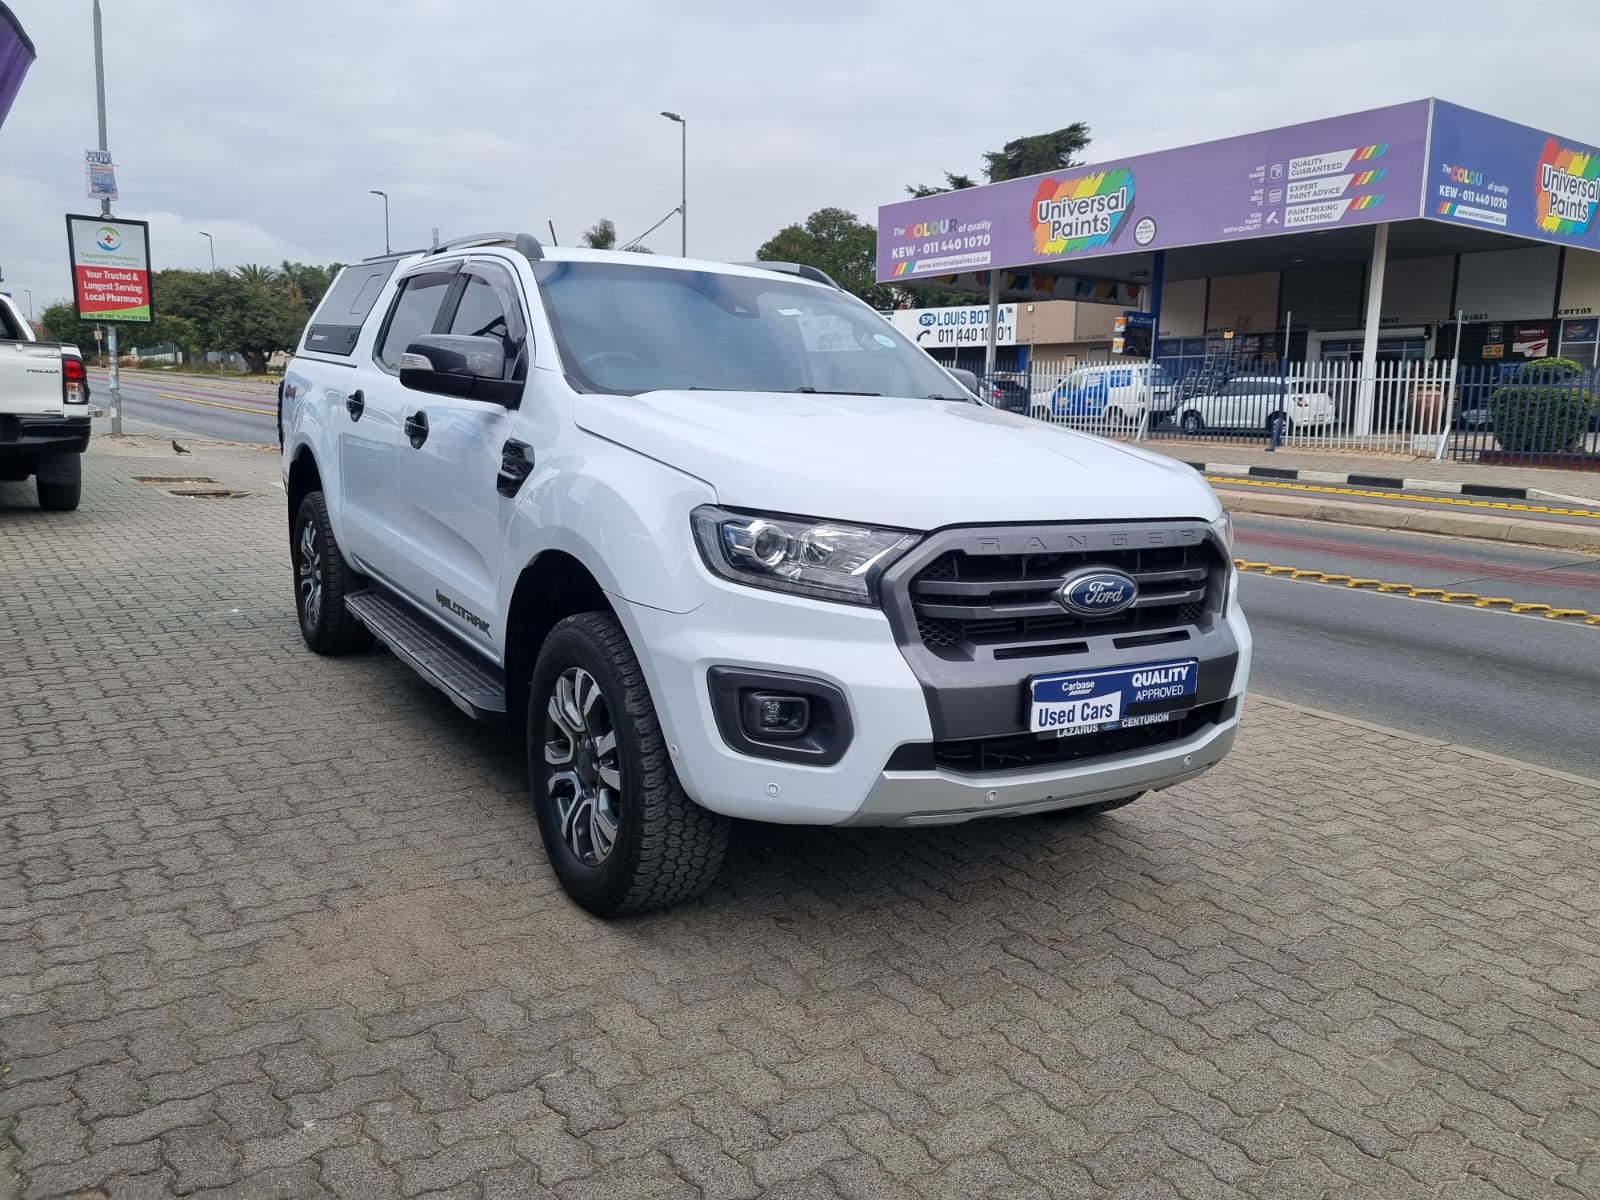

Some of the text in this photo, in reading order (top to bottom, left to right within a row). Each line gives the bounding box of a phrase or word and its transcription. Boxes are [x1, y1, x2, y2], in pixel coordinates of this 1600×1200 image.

[1291, 158, 1323, 169] QUALITY
[1291, 162, 1342, 176] GUARANTEED
[1290, 182, 1318, 192] EXPERT
[1442, 164, 1451, 174] The
[1487, 183, 1494, 191] of
[1493, 183, 1510, 196] quality
[1542, 164, 1600, 202] Universal
[1289, 187, 1341, 200] PAINT ADVICE
[1439, 184, 1458, 199] KEW
[1462, 190, 1474, 202] 011
[1475, 193, 1490, 205] 440
[1490, 195, 1508, 209] 1070
[1038, 189, 1126, 222] Universal
[1288, 203, 1339, 216] PAINT MIXING
[1549, 193, 1588, 221] Paints
[1295, 212, 1333, 222] MATCHING
[894, 218, 992, 239] The COLOUR of quality
[1051, 216, 1110, 240] Paints
[892, 245, 916, 259] KEW
[923, 241, 939, 254] 011
[941, 239, 962, 252] 440
[964, 234, 991, 249] 1070
[86, 270, 139, 281] Your Trusted &
[84, 281, 143, 294] Longest Serving
[85, 293, 143, 304] Local Pharmacy
[921, 308, 1005, 326] 575 LOUIS BOTA
[1558, 307, 1593, 315] COTTON
[938, 328, 954, 342] 011
[957, 327, 977, 342] 440
[977, 529, 1196, 551] RANGER
[1084, 581, 1124, 604] Ford
[1061, 680, 1095, 692] Carbase
[1131, 666, 1189, 688] QUALITY
[1135, 684, 1184, 702] APPROVED
[1038, 702, 1113, 728] Used Cars
[1056, 724, 1099, 739] LAZARUS
[1121, 713, 1170, 729] CENTURION
